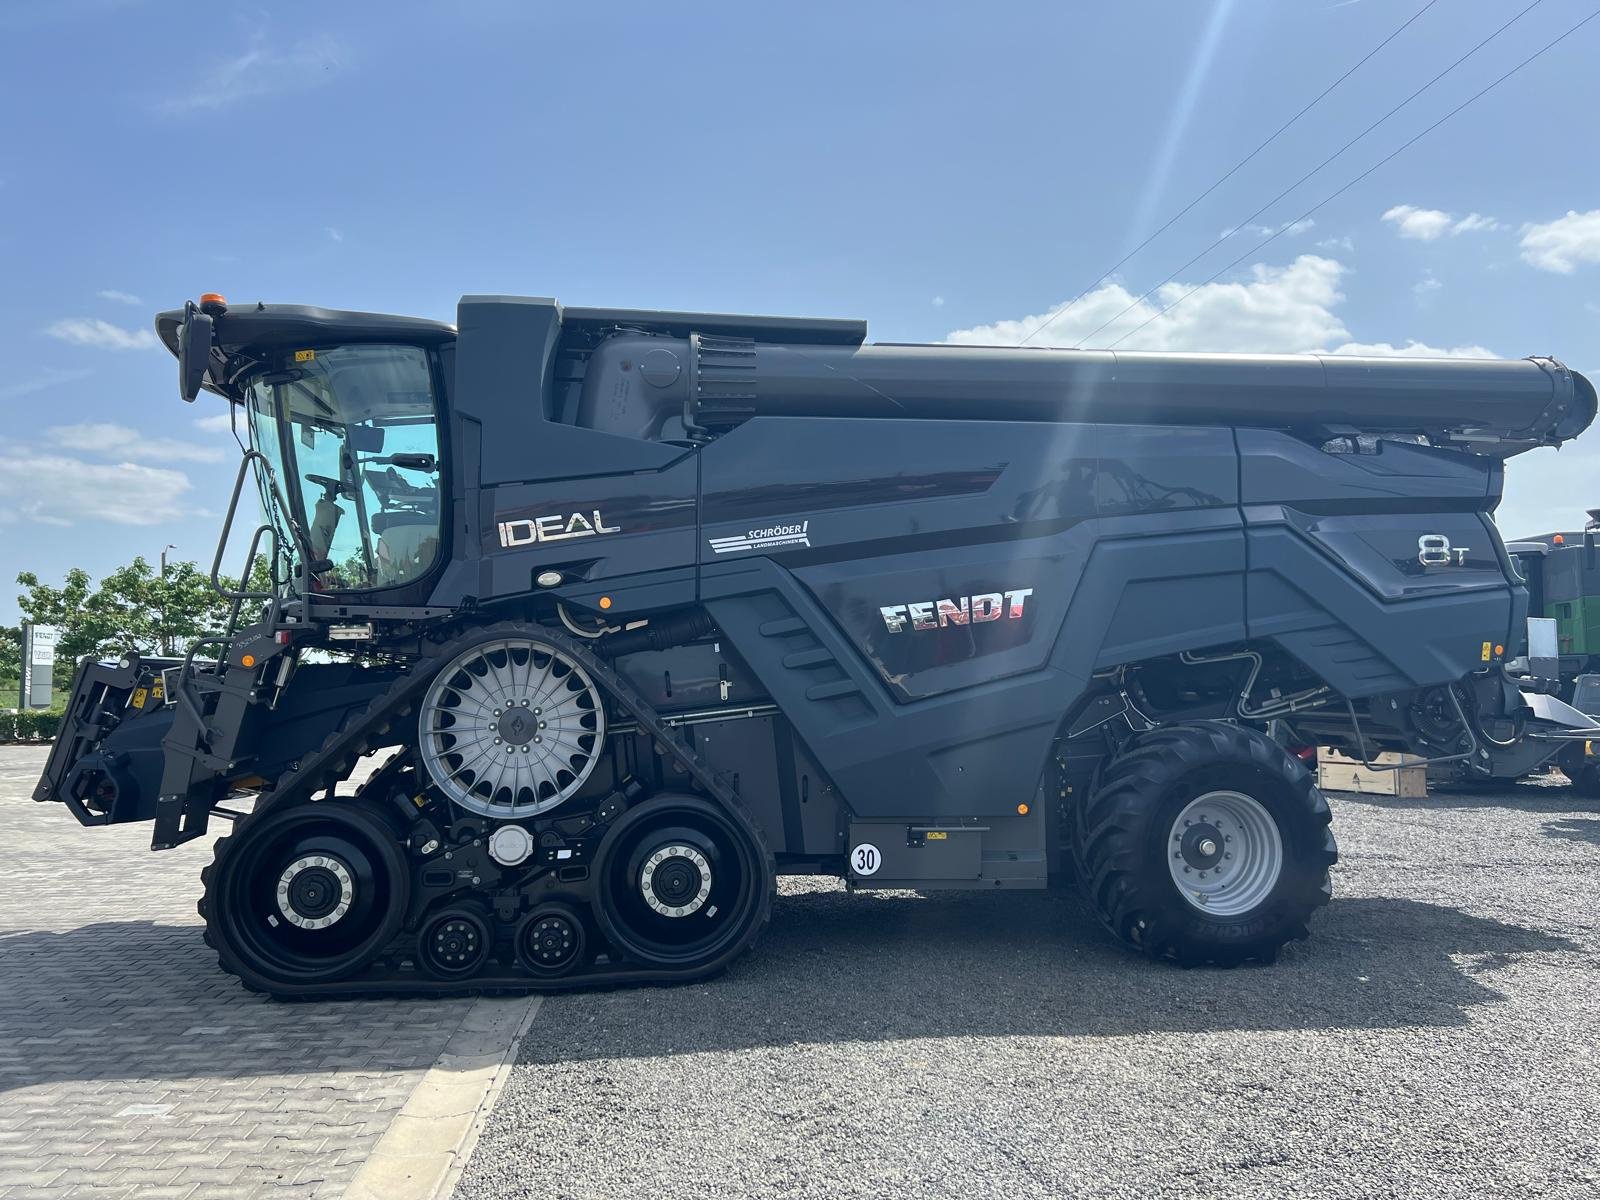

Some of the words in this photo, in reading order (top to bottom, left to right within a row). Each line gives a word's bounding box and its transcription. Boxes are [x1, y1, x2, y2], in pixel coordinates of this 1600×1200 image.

[498, 510, 620, 547] IDEAL
[747, 524, 801, 539] SCHRÖDER
[753, 538, 799, 549] LANDMASCHINEN
[880, 588, 1033, 634] FENDT
[857, 849, 875, 870] 30
